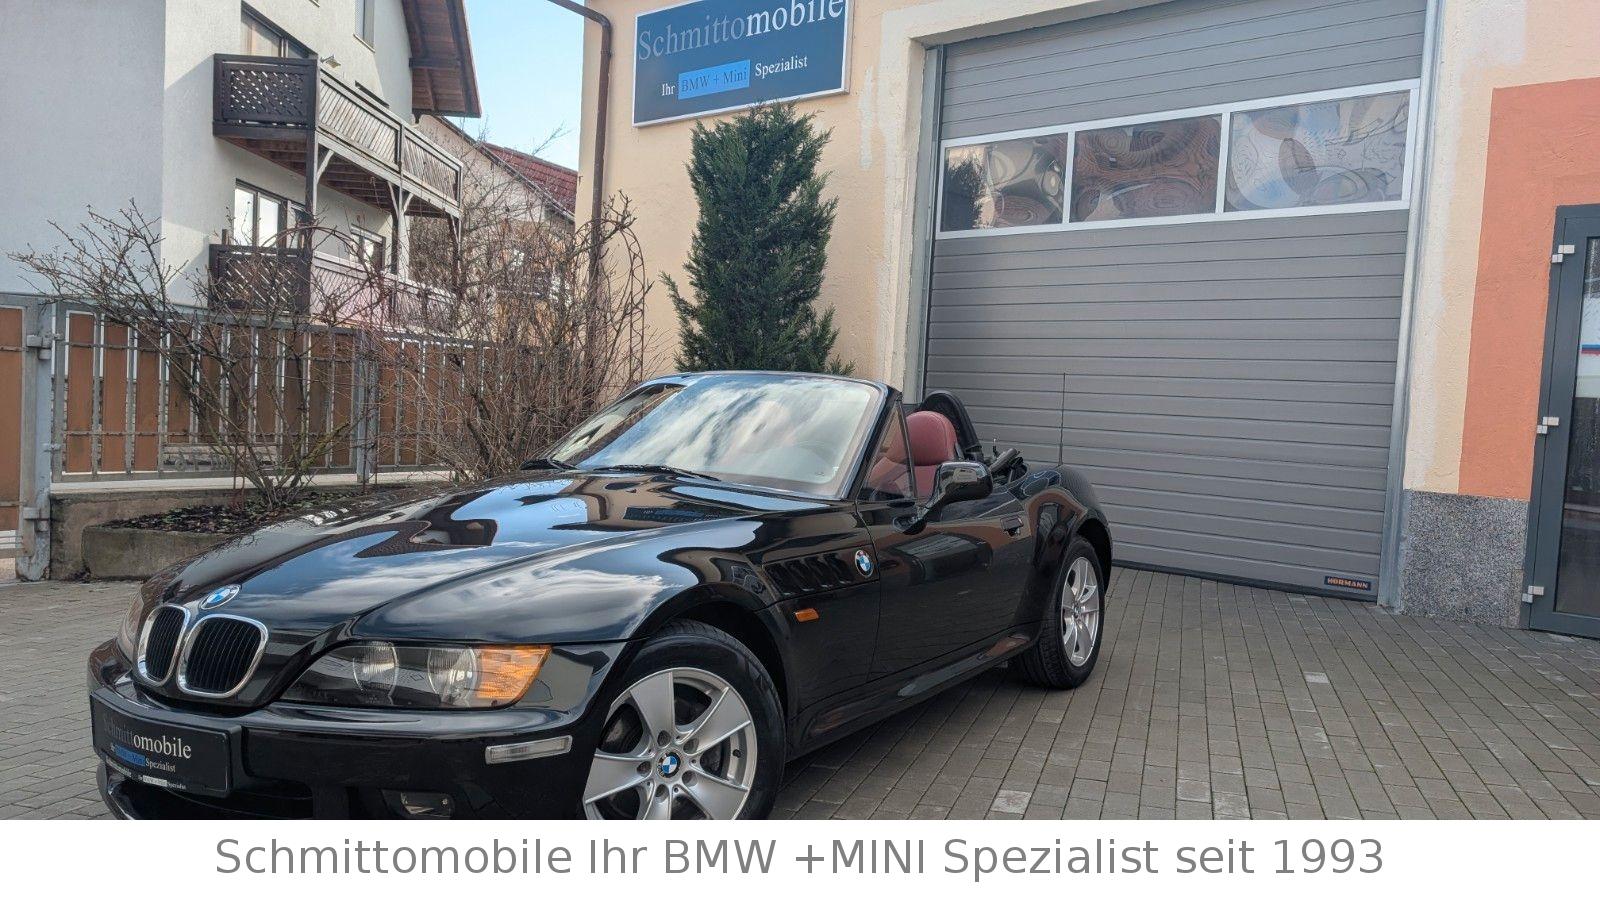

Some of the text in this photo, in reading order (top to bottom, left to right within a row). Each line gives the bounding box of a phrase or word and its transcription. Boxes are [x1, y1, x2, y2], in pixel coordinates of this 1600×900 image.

[638, 0, 844, 61] Schmittomobile
[662, 83, 675, 97] Ihr
[681, 74, 711, 92] BMW
[723, 66, 747, 84] Mini
[755, 56, 808, 79] Spezialist
[145, 758, 176, 773] Spezialist
